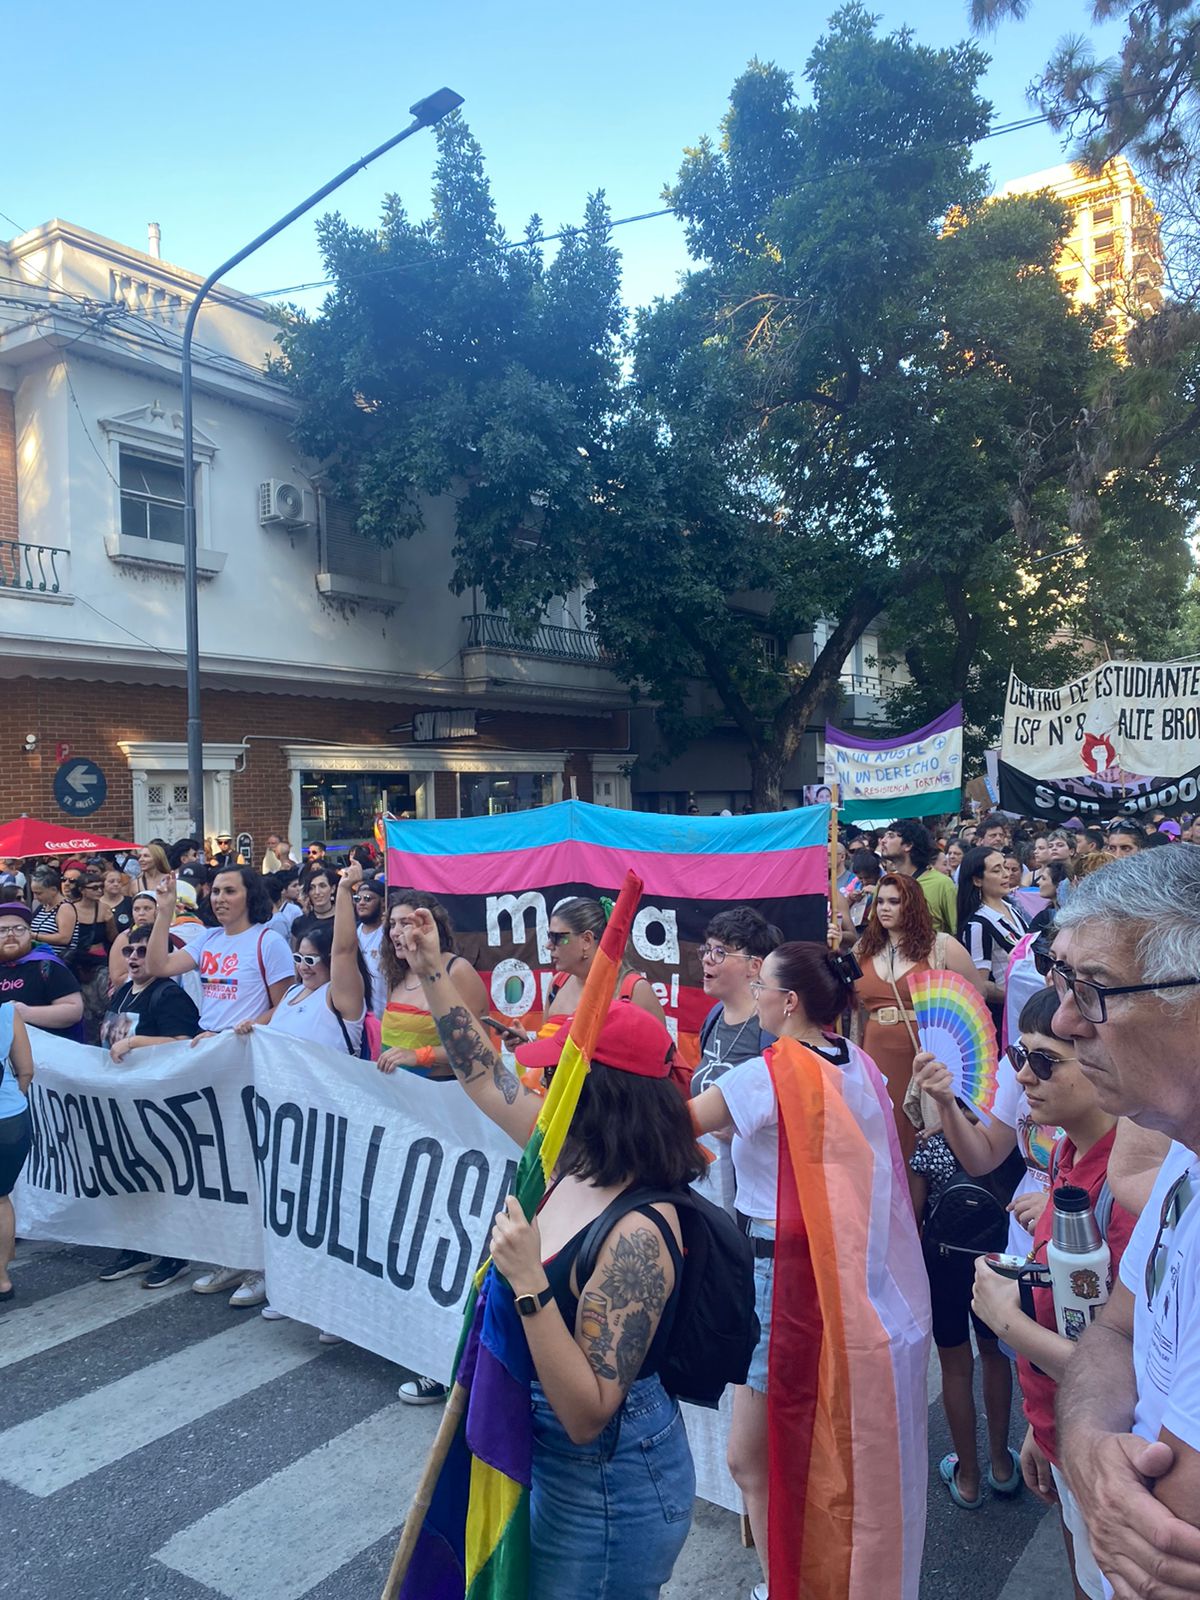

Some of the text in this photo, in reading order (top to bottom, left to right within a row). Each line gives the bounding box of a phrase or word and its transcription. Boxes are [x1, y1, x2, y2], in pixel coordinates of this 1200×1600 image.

[1009, 675, 1061, 711] CENTRO
[1069, 678, 1089, 705] DE
[1014, 716, 1042, 746] ISP
[1118, 708, 1155, 741] ALTE
[836, 745, 926, 764] NI UN AJUSTE
[838, 772, 850, 785] NI
[856, 771, 871, 784] UN
[875, 756, 939, 782] DERECHO
[1034, 785, 1100, 815] Son
[1119, 774, 1200, 816] 3000
[28, 1082, 165, 1198] MARCHA
[133, 1086, 249, 1204] DEL
